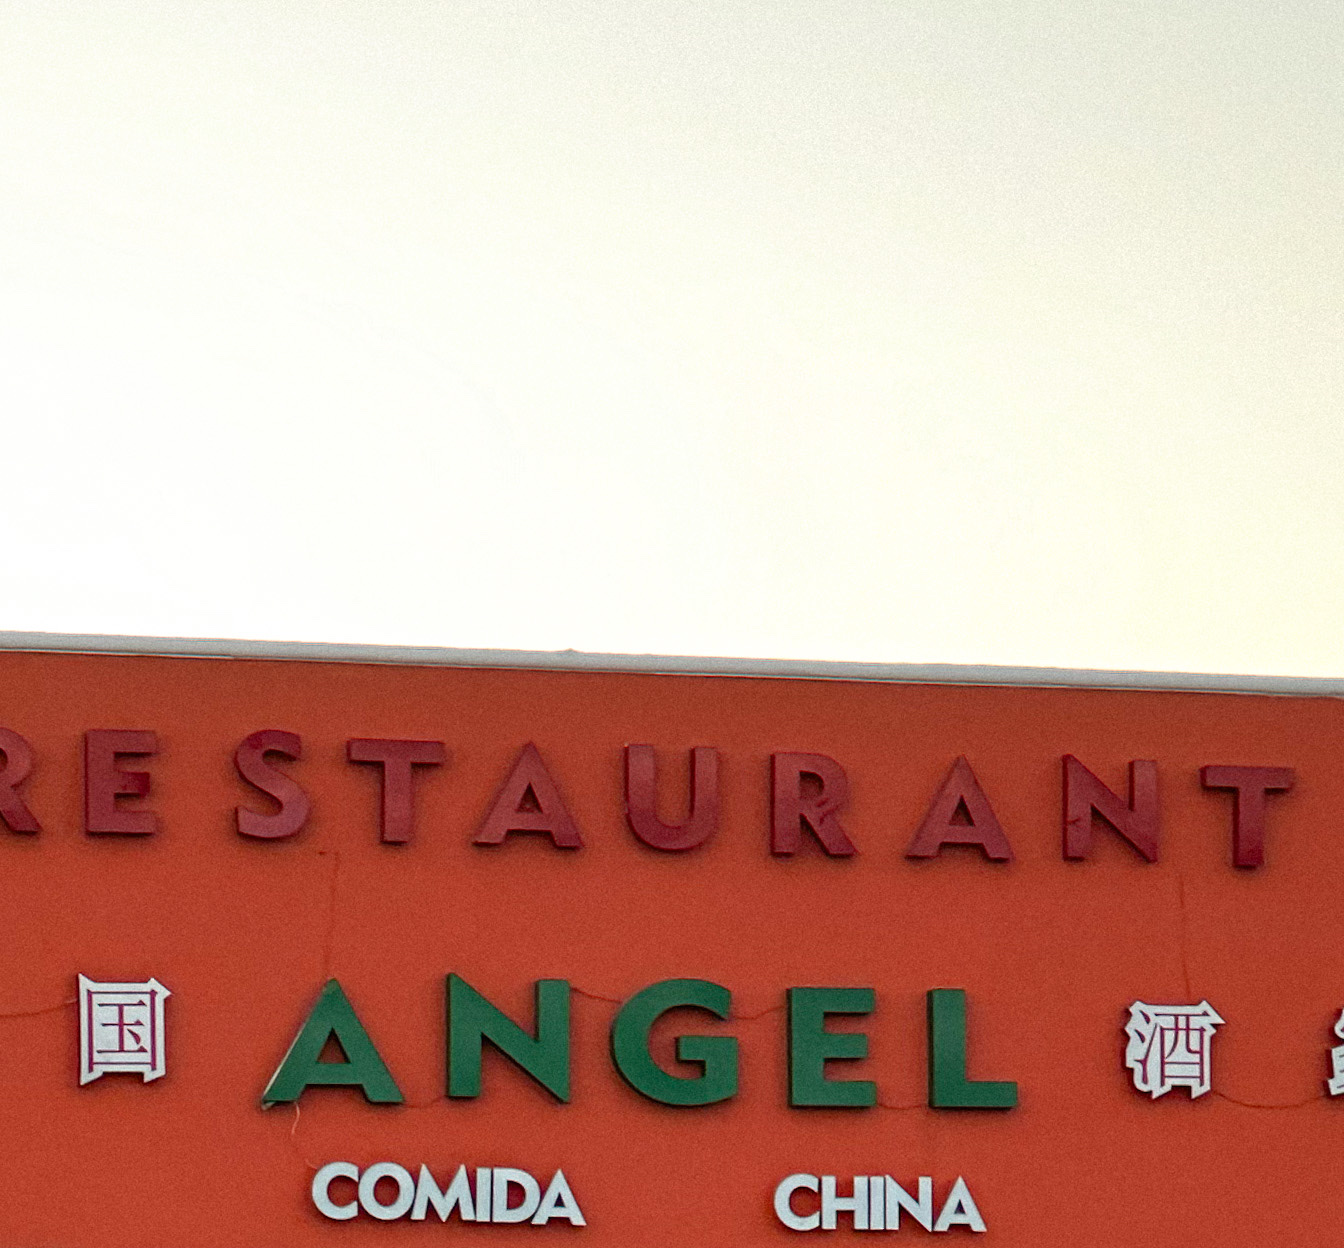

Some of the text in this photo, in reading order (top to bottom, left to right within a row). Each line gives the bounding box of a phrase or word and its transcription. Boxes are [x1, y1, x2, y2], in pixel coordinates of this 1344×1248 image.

[260, 971, 1019, 1111] ANGEL
[311, 1161, 988, 1234] COMIDA CHINA
